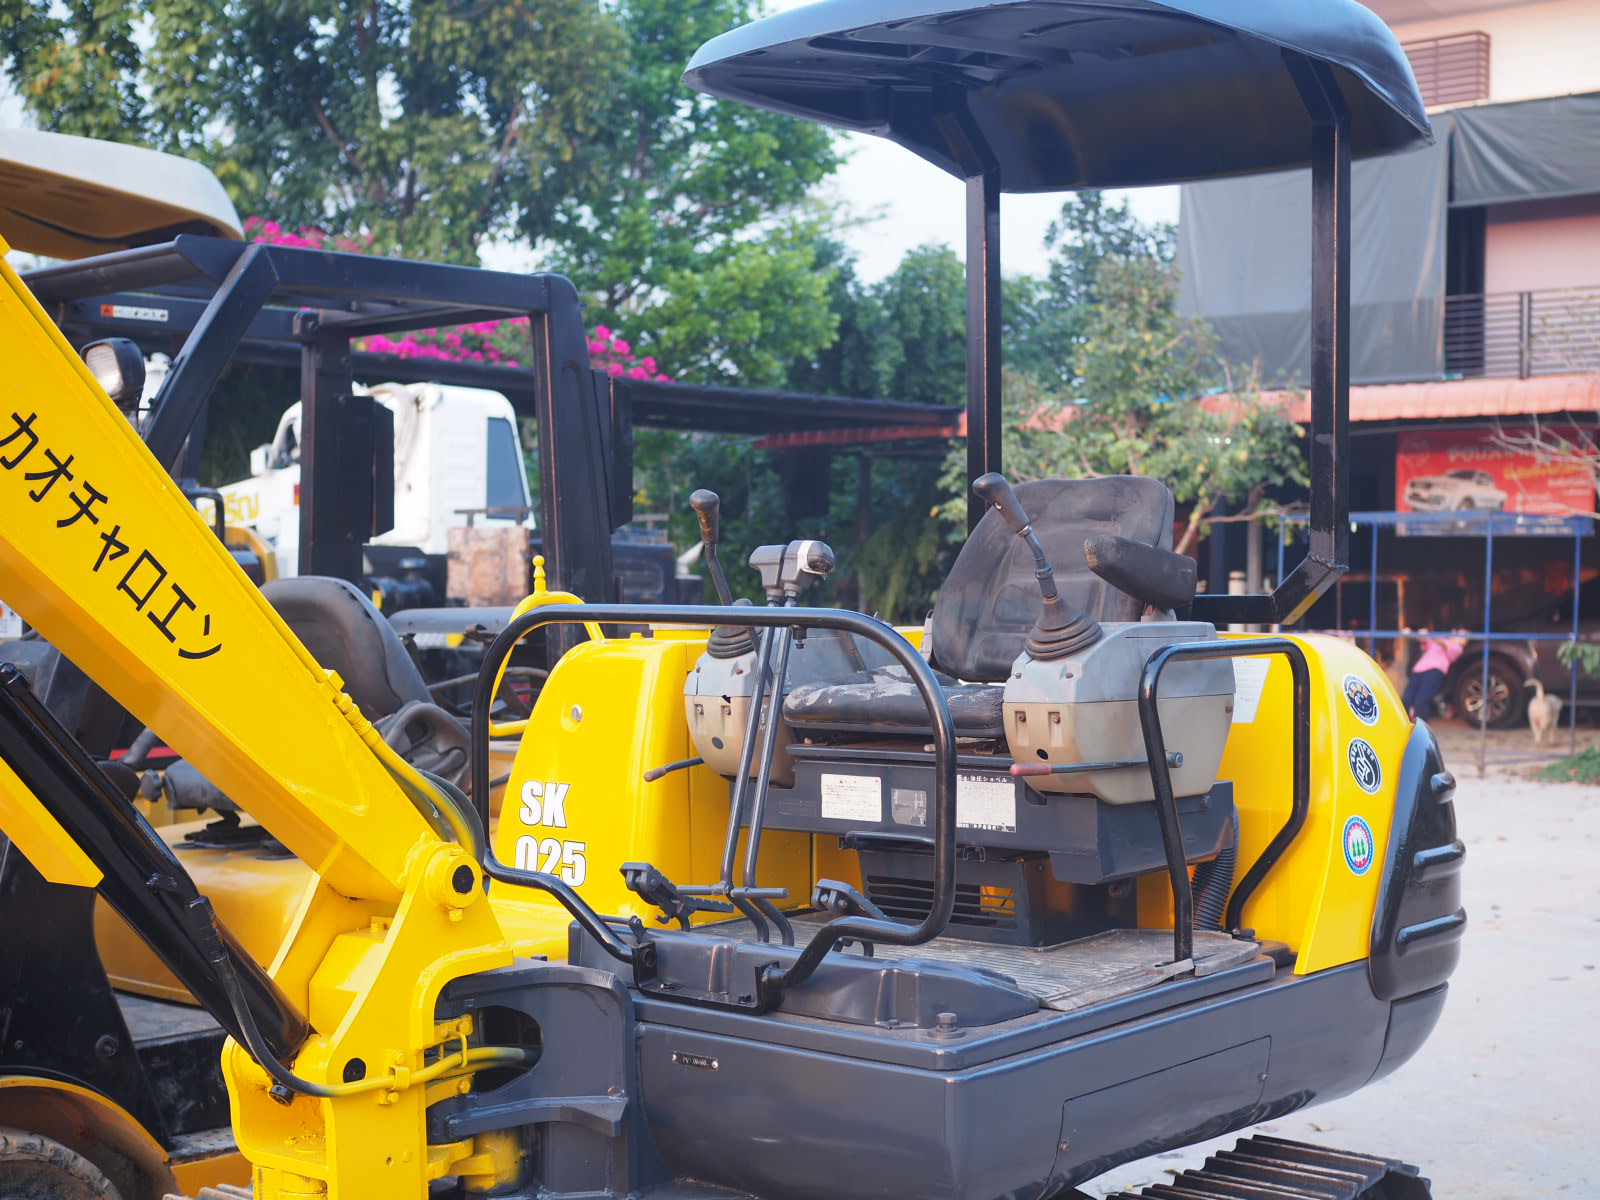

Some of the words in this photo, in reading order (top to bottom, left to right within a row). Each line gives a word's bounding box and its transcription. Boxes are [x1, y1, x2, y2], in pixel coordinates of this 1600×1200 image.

[0, 412, 223, 660] カオチャロエン
[519, 780, 570, 828] SK
[514, 835, 587, 887] 025
